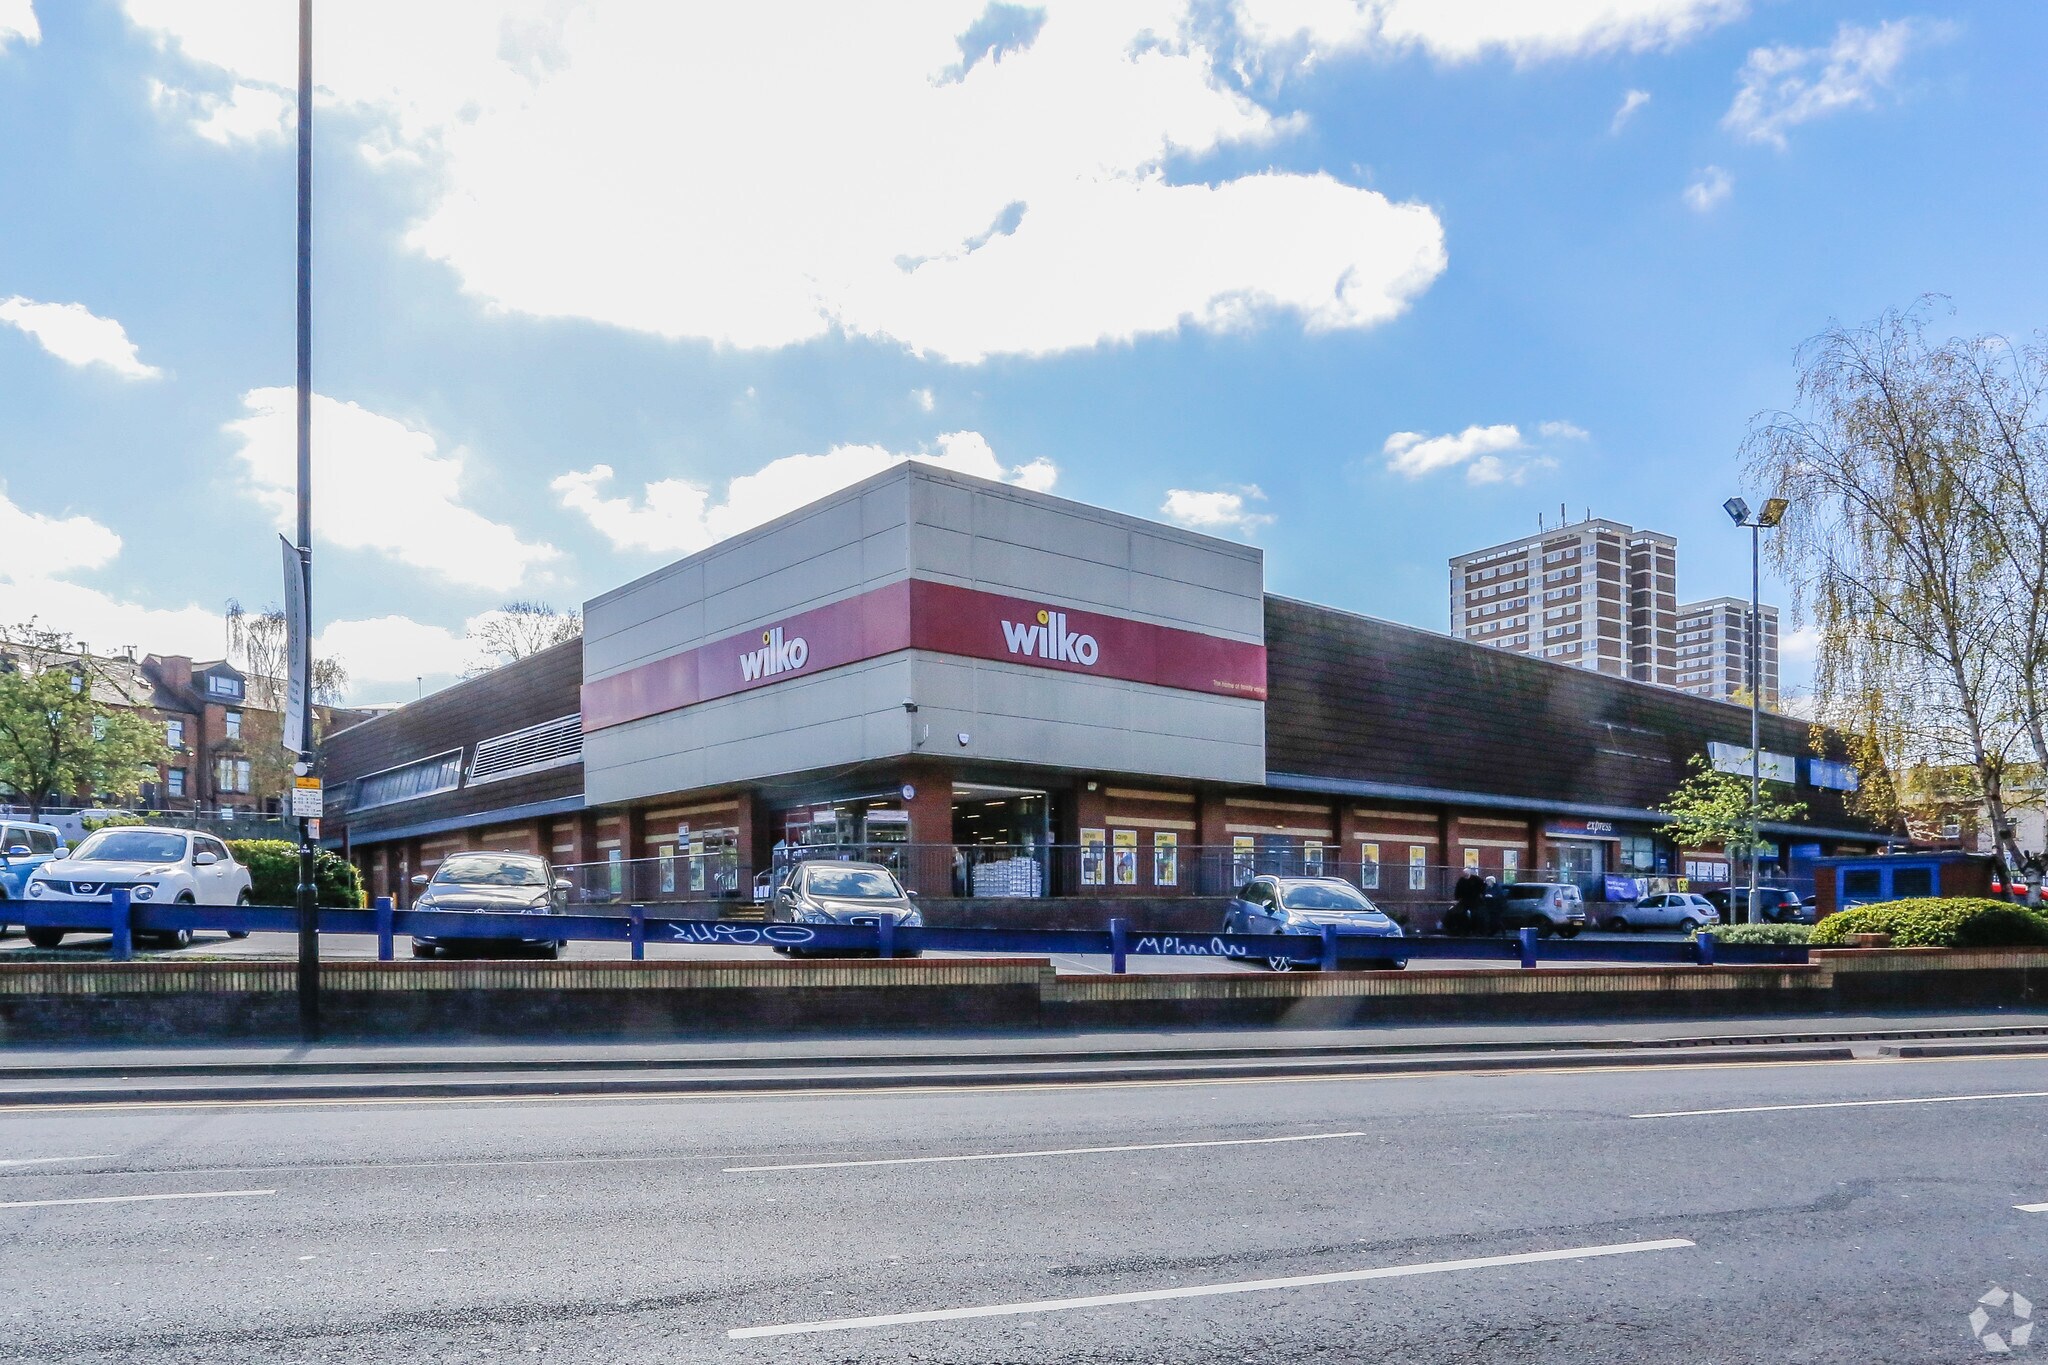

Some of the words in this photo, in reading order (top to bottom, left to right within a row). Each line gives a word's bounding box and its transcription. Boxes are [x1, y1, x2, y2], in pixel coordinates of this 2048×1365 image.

[740, 626, 809, 682] wilko
[1001, 610, 1099, 666] wilko
[1586, 820, 1612, 834] express
